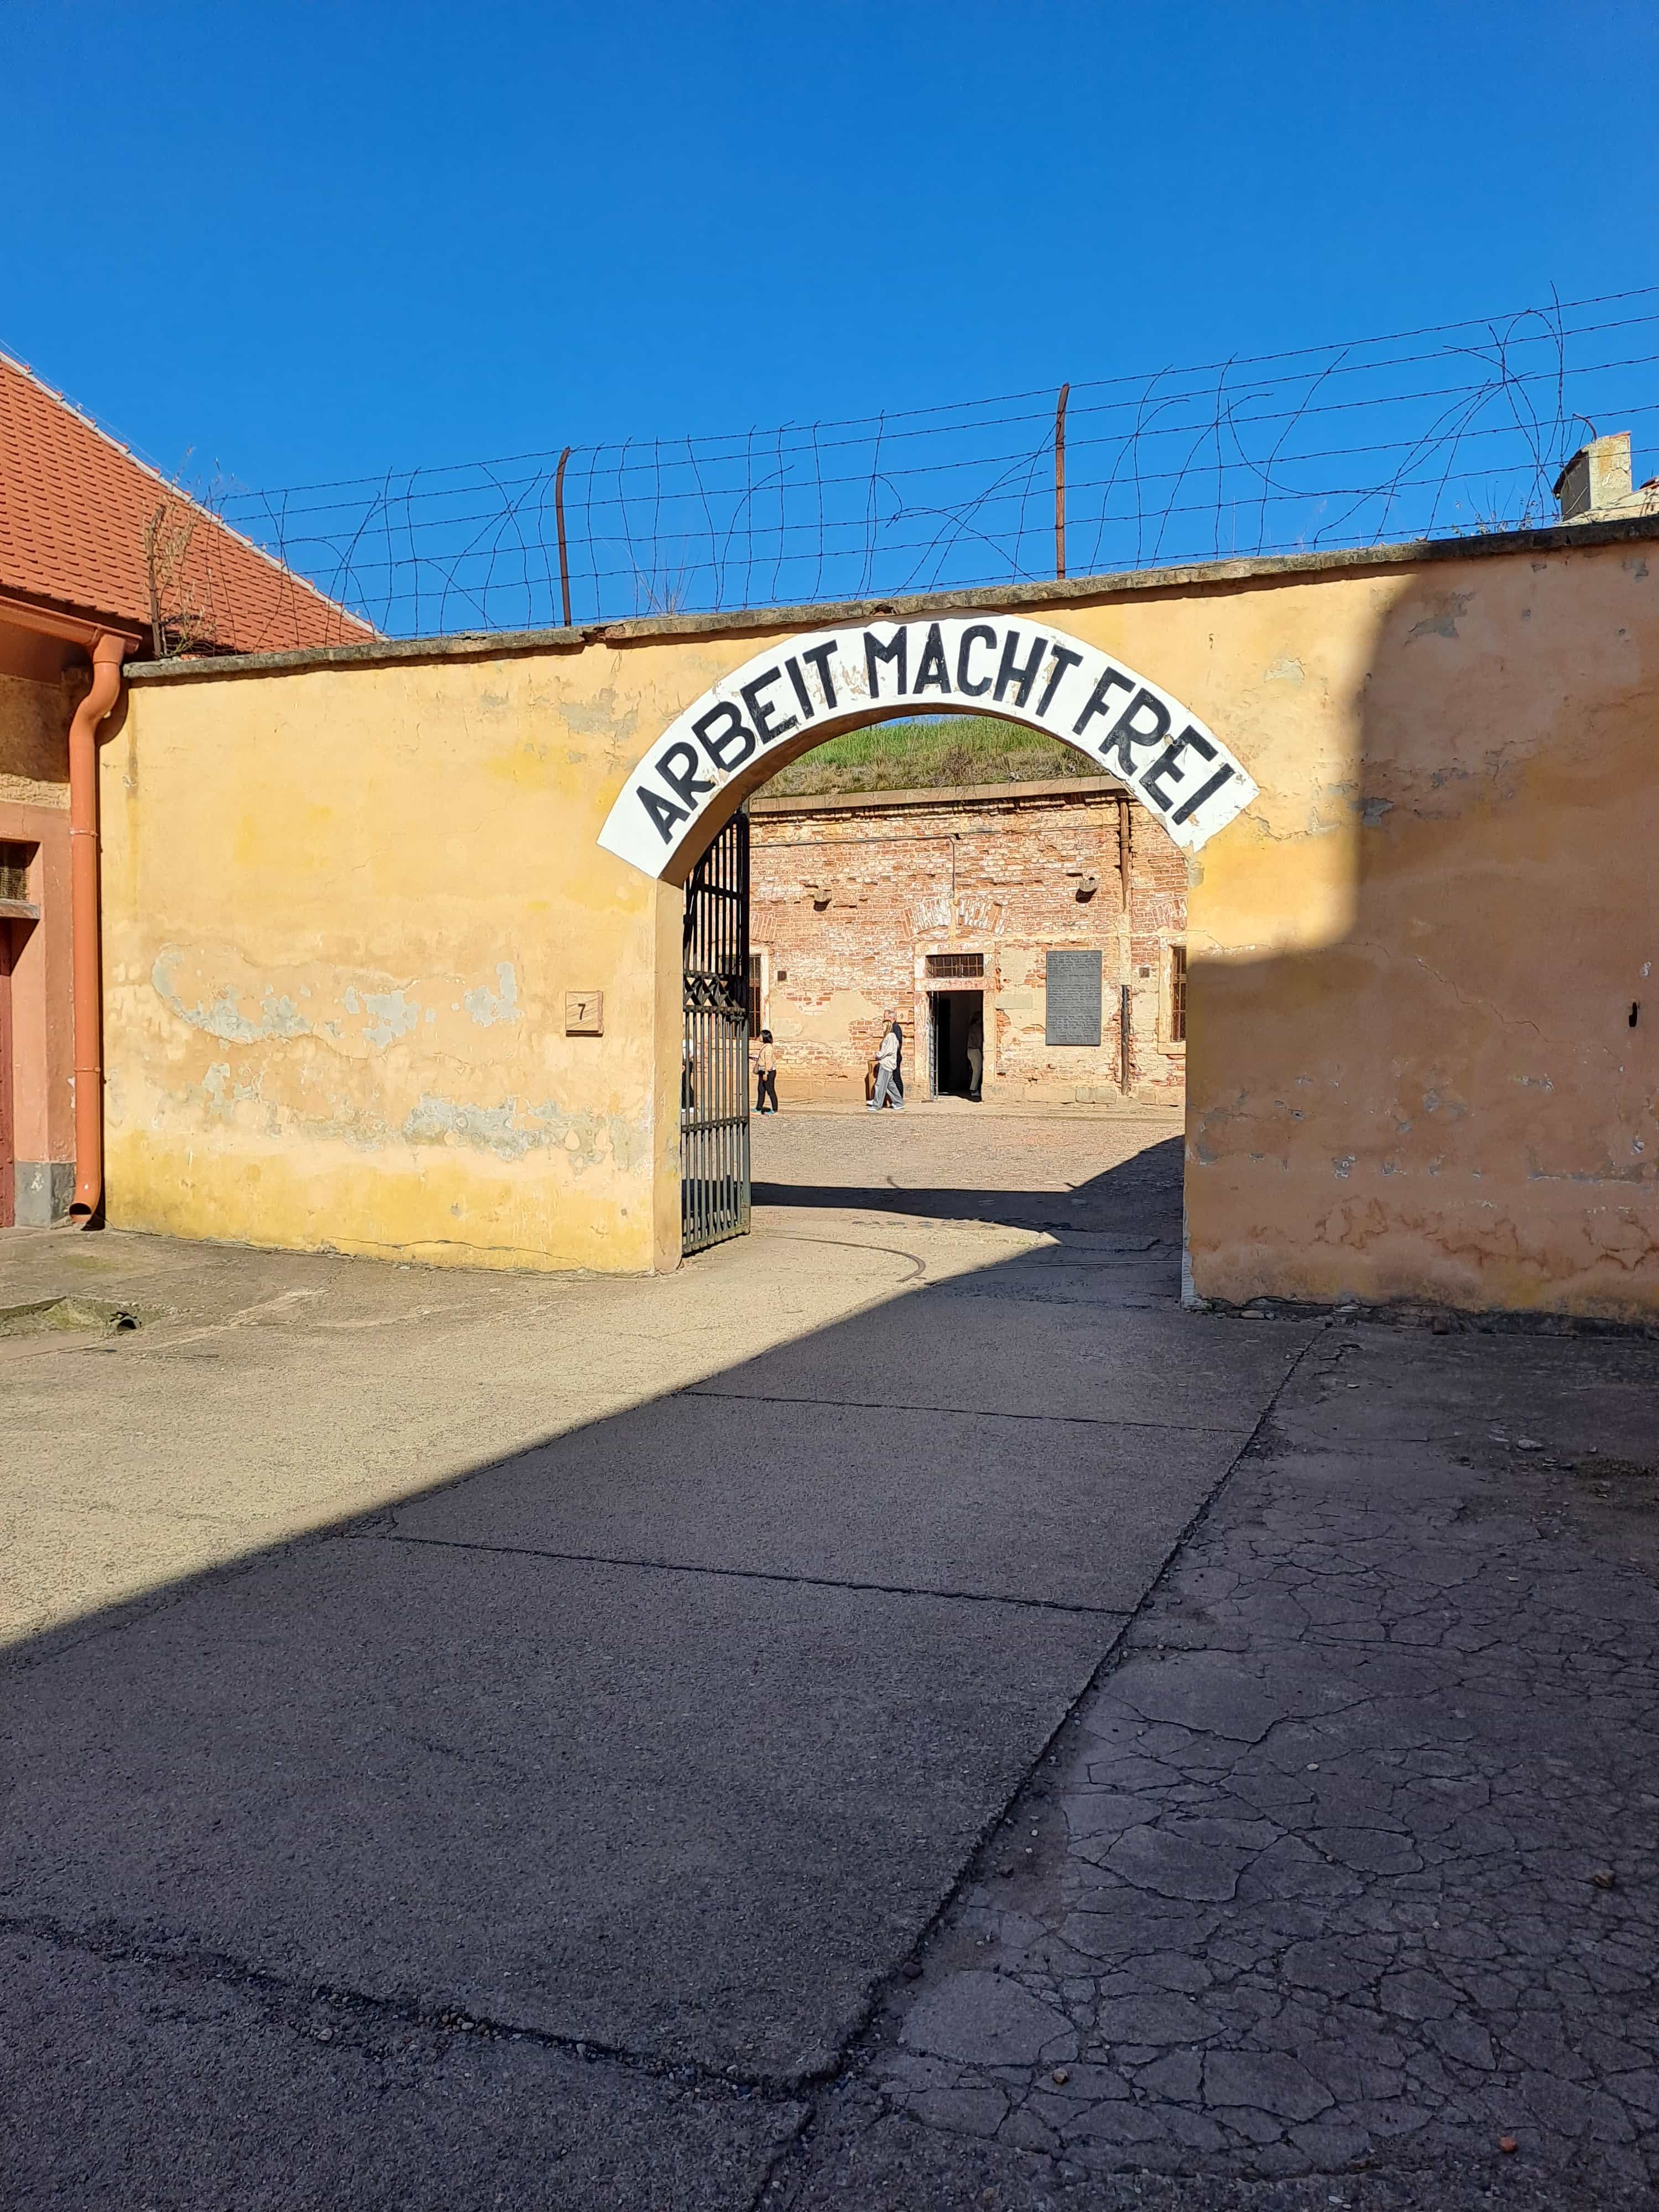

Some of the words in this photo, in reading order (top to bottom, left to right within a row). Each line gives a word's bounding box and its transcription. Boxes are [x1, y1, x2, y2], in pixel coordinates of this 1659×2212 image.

[636, 640, 838, 844] ARBEIT
[863, 623, 1083, 717] MACHT
[1072, 666, 1238, 826] FREI
[578, 1003, 586, 1020] 7
